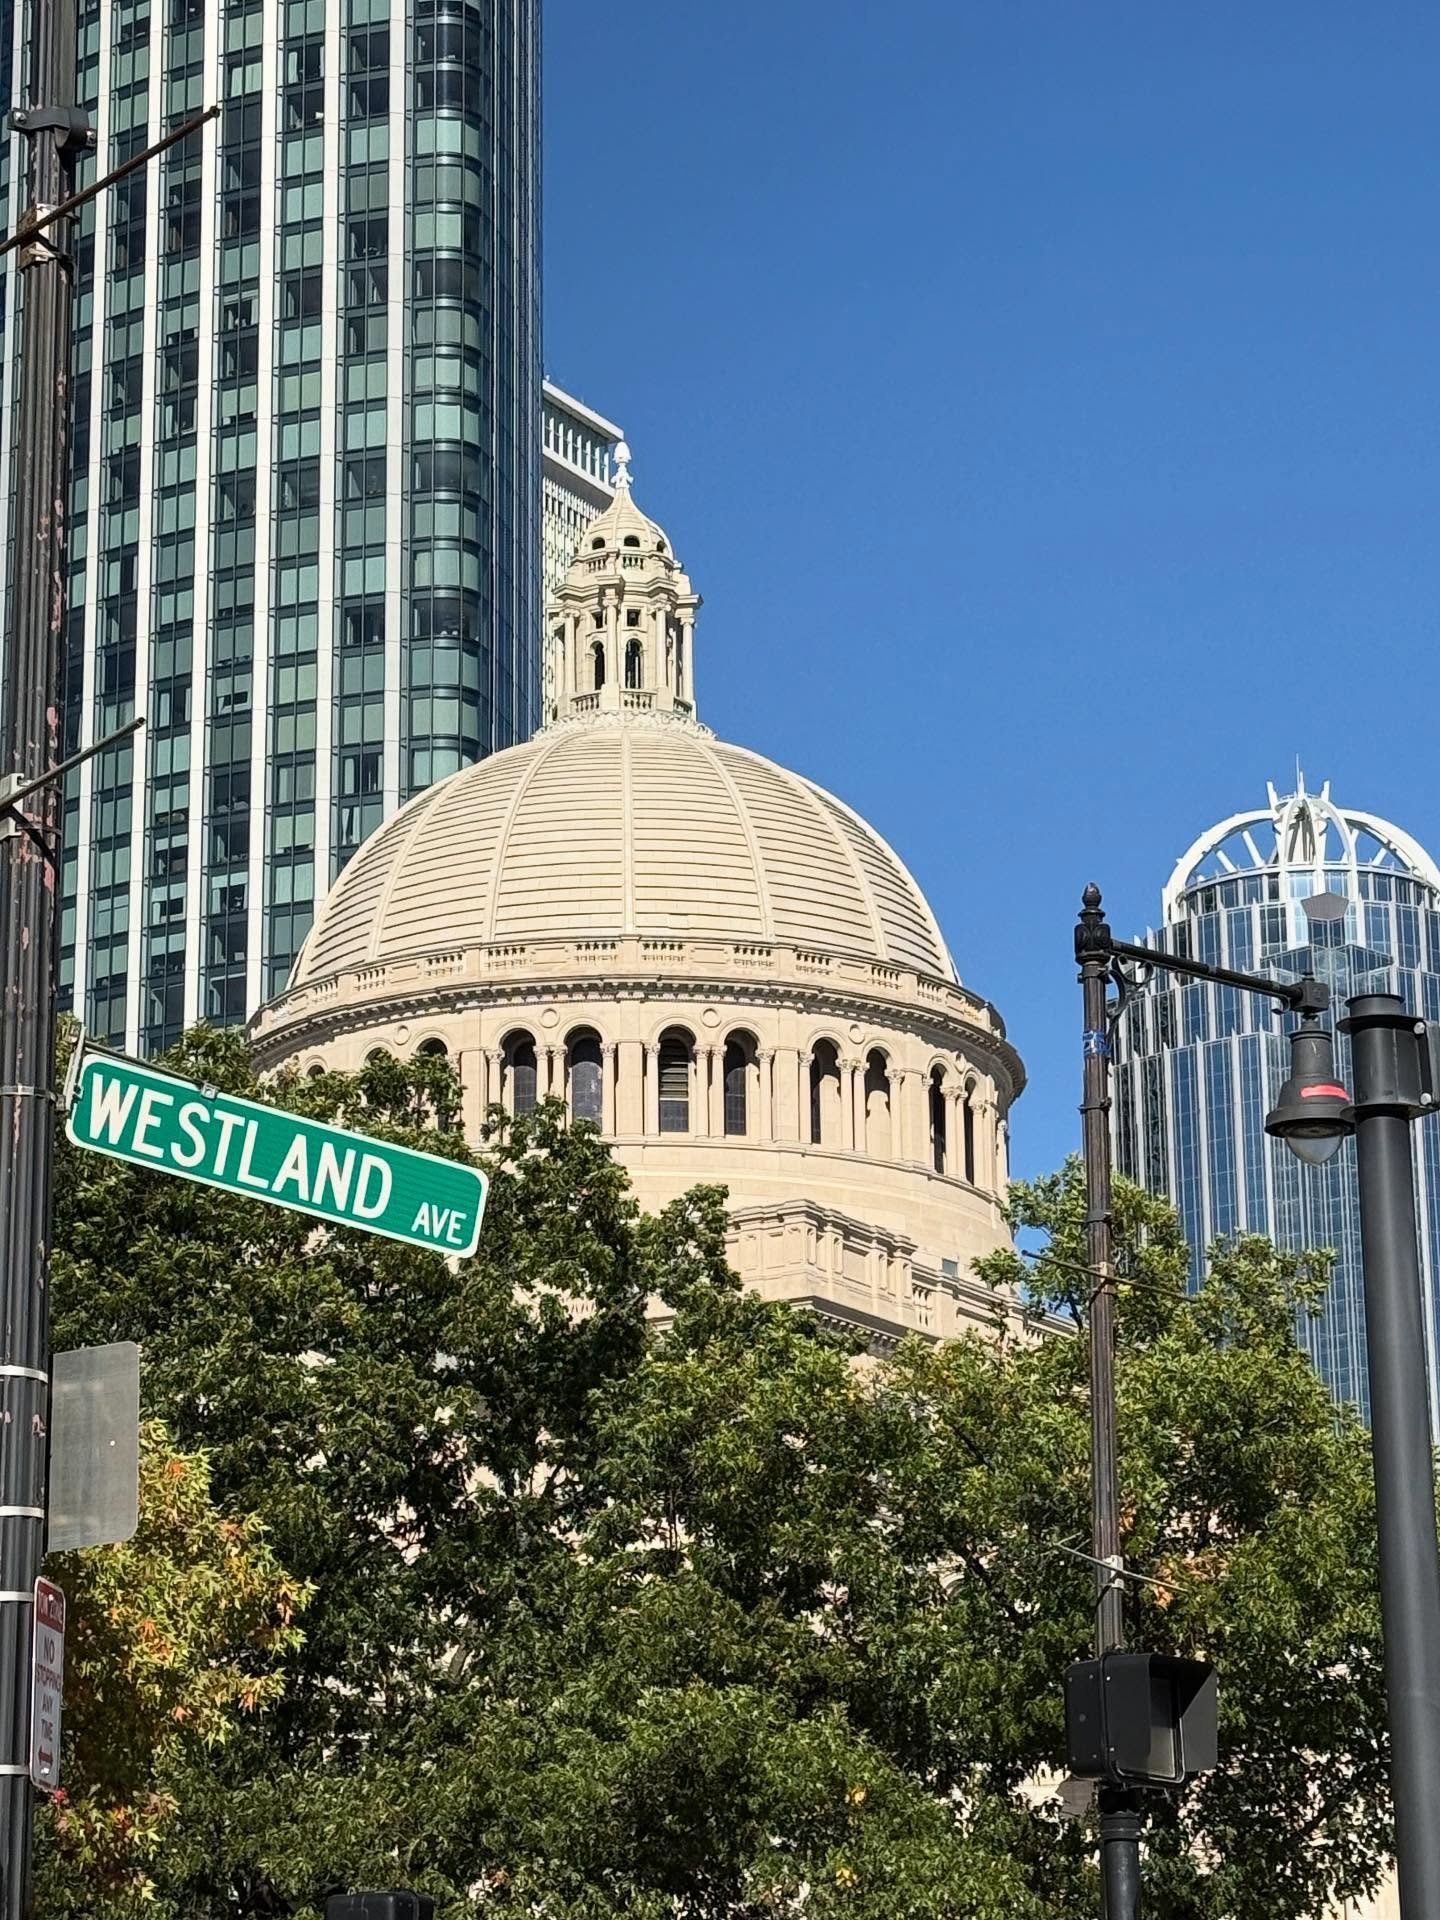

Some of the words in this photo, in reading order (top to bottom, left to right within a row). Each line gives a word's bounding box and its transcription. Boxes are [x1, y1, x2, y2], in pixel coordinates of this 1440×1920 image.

[89, 1073, 393, 1219] WESTLAND
[411, 1202, 467, 1245] AVE
[43, 1636, 55, 1665] NO
[36, 1663, 61, 1694] STOPPING
[42, 1693, 53, 1714] ANY
[40, 1718, 53, 1742] TIME
